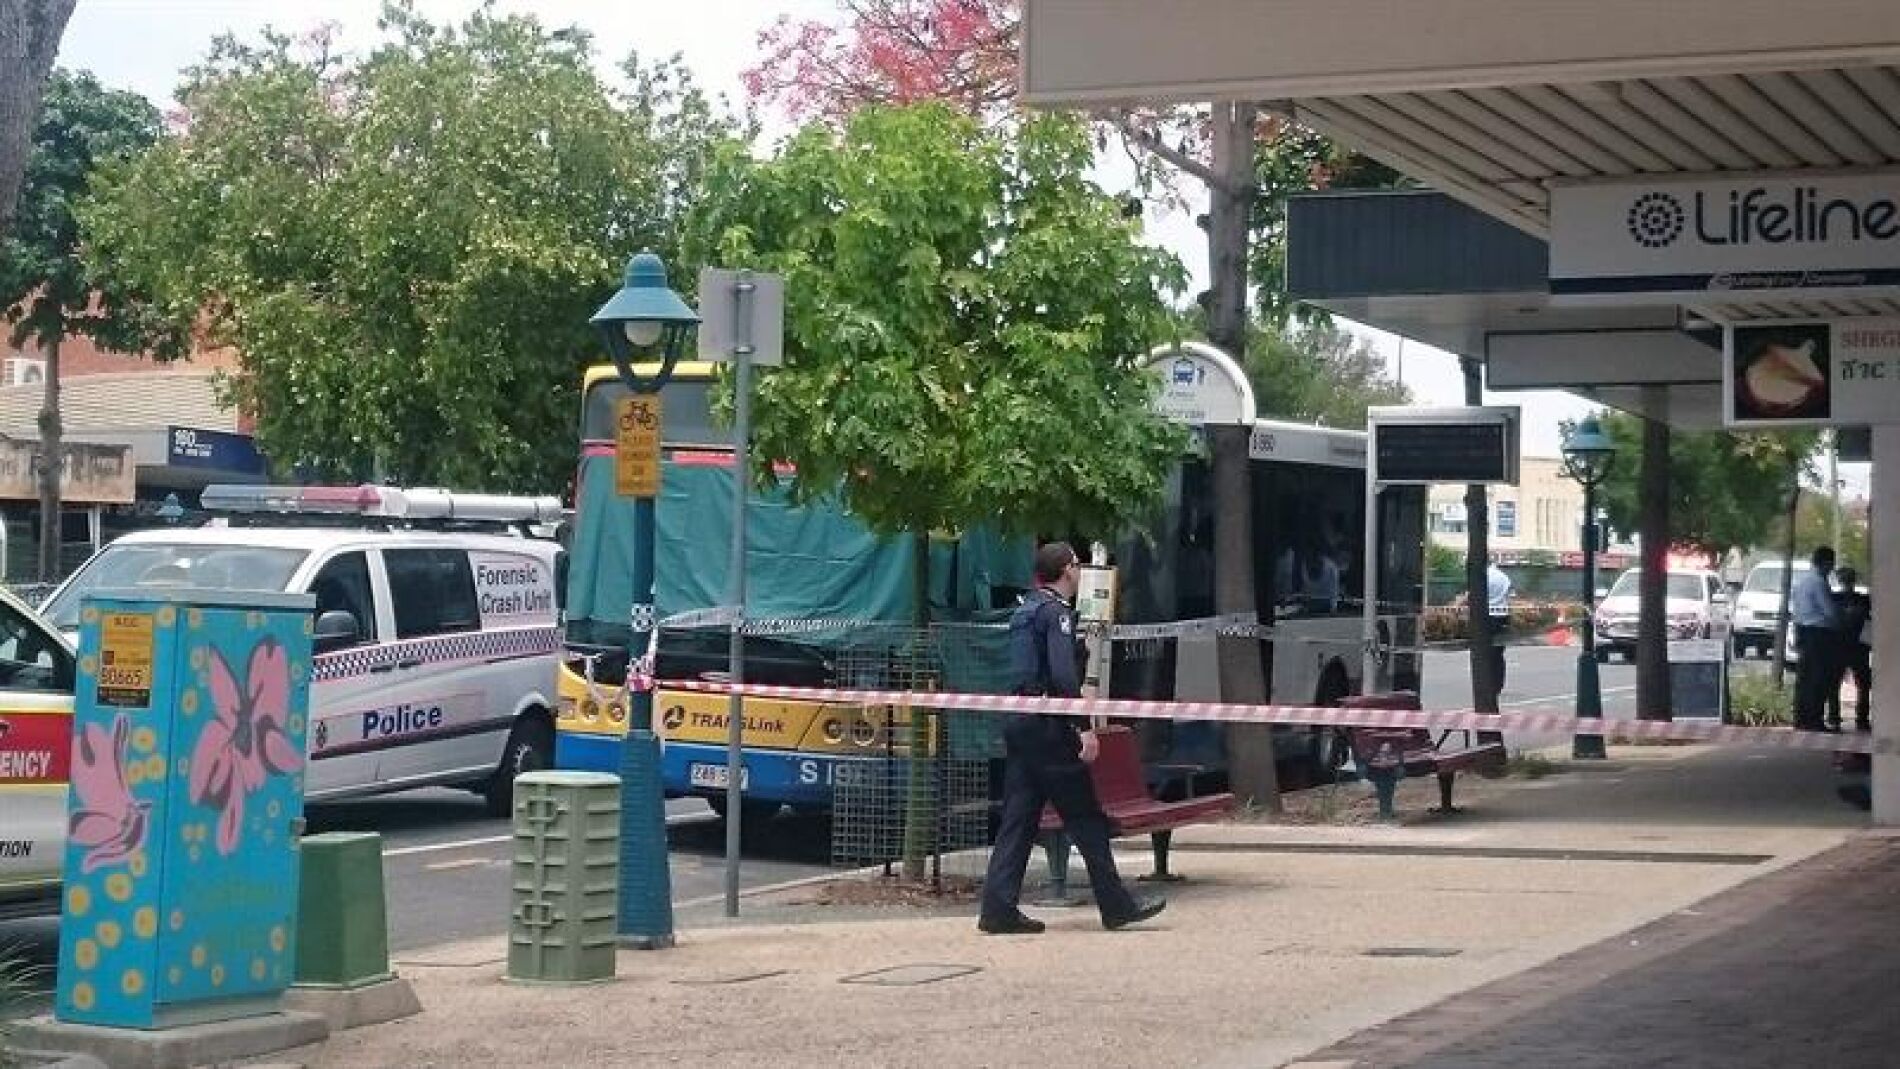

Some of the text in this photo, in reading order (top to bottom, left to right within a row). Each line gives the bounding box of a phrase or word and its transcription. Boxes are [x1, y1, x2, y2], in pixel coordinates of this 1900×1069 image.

[1695, 186, 1900, 246] Lifeline
[477, 563, 538, 586] Forensic
[480, 589, 552, 614] Crash Unit
[362, 704, 443, 740] Police
